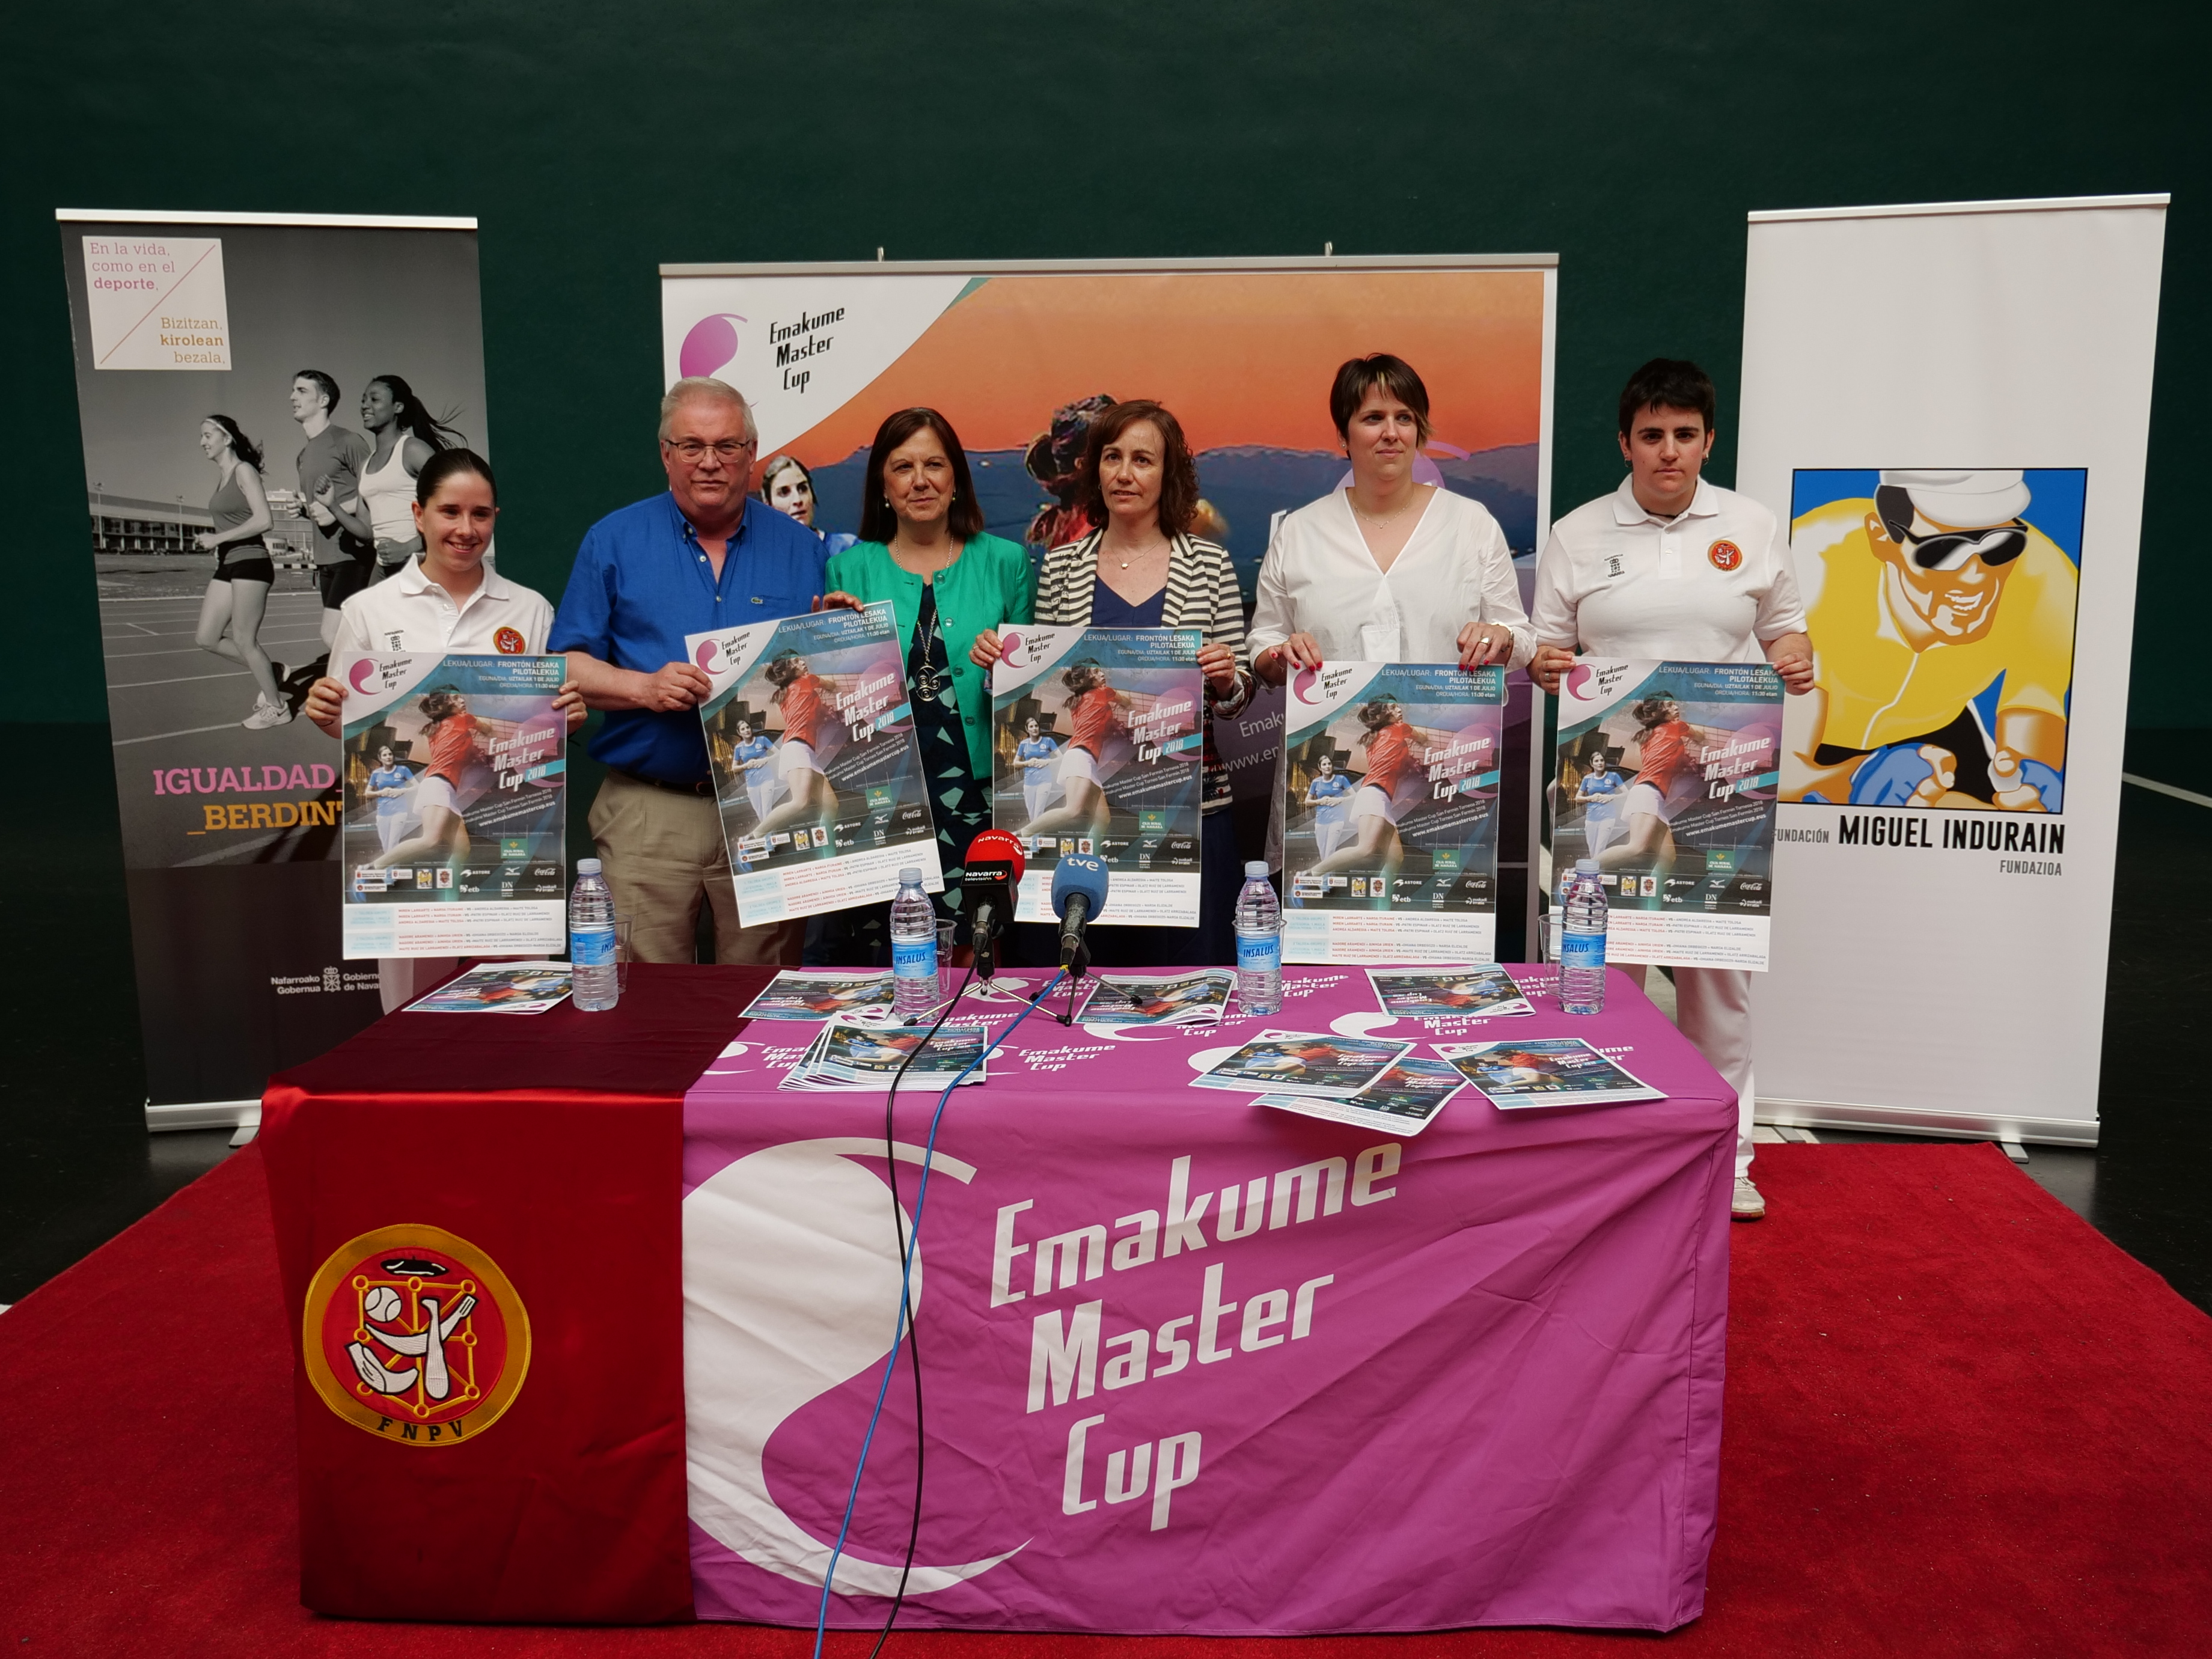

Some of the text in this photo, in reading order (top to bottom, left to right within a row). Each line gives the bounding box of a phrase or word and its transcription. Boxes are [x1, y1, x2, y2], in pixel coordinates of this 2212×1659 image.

[90, 243, 109, 255] En
[115, 242, 129, 255] la
[92, 261, 175, 273] como en el
[769, 307, 845, 344] Emakume
[160, 334, 224, 346] kirolean
[777, 335, 834, 368] Master
[783, 368, 810, 394] Cup
[843, 616, 888, 628] PILOTALEKUA
[861, 609, 887, 618] LESAKA
[721, 631, 751, 651] Emakume
[726, 642, 748, 657] Master
[1025, 632, 1055, 646] Emakume
[1027, 642, 1051, 653] Master
[379, 658, 412, 672] Emakume
[730, 655, 741, 665] Cup
[1030, 654, 1041, 664] Cup
[382, 668, 407, 680] Master
[1321, 667, 1352, 682] Emakume
[1596, 664, 1628, 678] Emakume
[1598, 674, 1622, 686] Master
[385, 679, 397, 690] Cup
[836, 672, 896, 711] Emakume
[1324, 677, 1347, 690] Master
[1600, 686, 1612, 697] Cup
[1326, 689, 1337, 700] Cup
[845, 693, 889, 727] Master
[1128, 700, 1193, 729] Emakume
[852, 712, 895, 743] Cup 2018
[1133, 721, 1182, 745] Master
[1239, 711, 1284, 738] Emak
[489, 728, 555, 756] Emakume
[1423, 737, 1491, 765] Emakume
[1700, 736, 1771, 765] Emakume
[493, 747, 544, 772] Master
[842, 744, 909, 781] www.emakumemastercup.eus
[1138, 741, 1184, 765] Cup 2018
[499, 766, 546, 792] Cup 2018
[1428, 757, 1479, 783] Master
[1705, 757, 1758, 782] Master
[1118, 775, 1193, 799] www.emakumemastercup.eus
[1433, 777, 1480, 802] Cup 2018
[1709, 777, 1759, 802] Cup 2018
[187, 801, 344, 835] _BERDIN
[478, 801, 555, 827] www.emakumemastercup.eus
[1413, 813, 1488, 837] www.emakumemastercup.eus
[1685, 814, 1767, 837] www.emakumemastercup.eus
[1839, 814, 1932, 848] MIGUEL
[1943, 819, 2065, 854] INDURAIN
[1066, 857, 1099, 871] tve
[2000, 860, 2062, 876] FUNDAZIOA
[896, 952, 926, 965] INSALUS
[1244, 945, 1274, 958] INSALUS
[1563, 944, 1589, 953] NSALUS
[271, 972, 380, 985] Nafarroako Gobierno
[277, 985, 320, 994] Gobernua
[358, 982, 380, 990] Nava
[1425, 1018, 1491, 1028] Master
[1018, 1043, 1116, 1057] Emakume
[1024, 1054, 1101, 1063] Master
[991, 1143, 1402, 1309] Emakume
[1027, 1262, 1334, 1414] Master
[377, 1416, 464, 1441] FNPV
[1062, 1413, 1202, 1532] Cup
